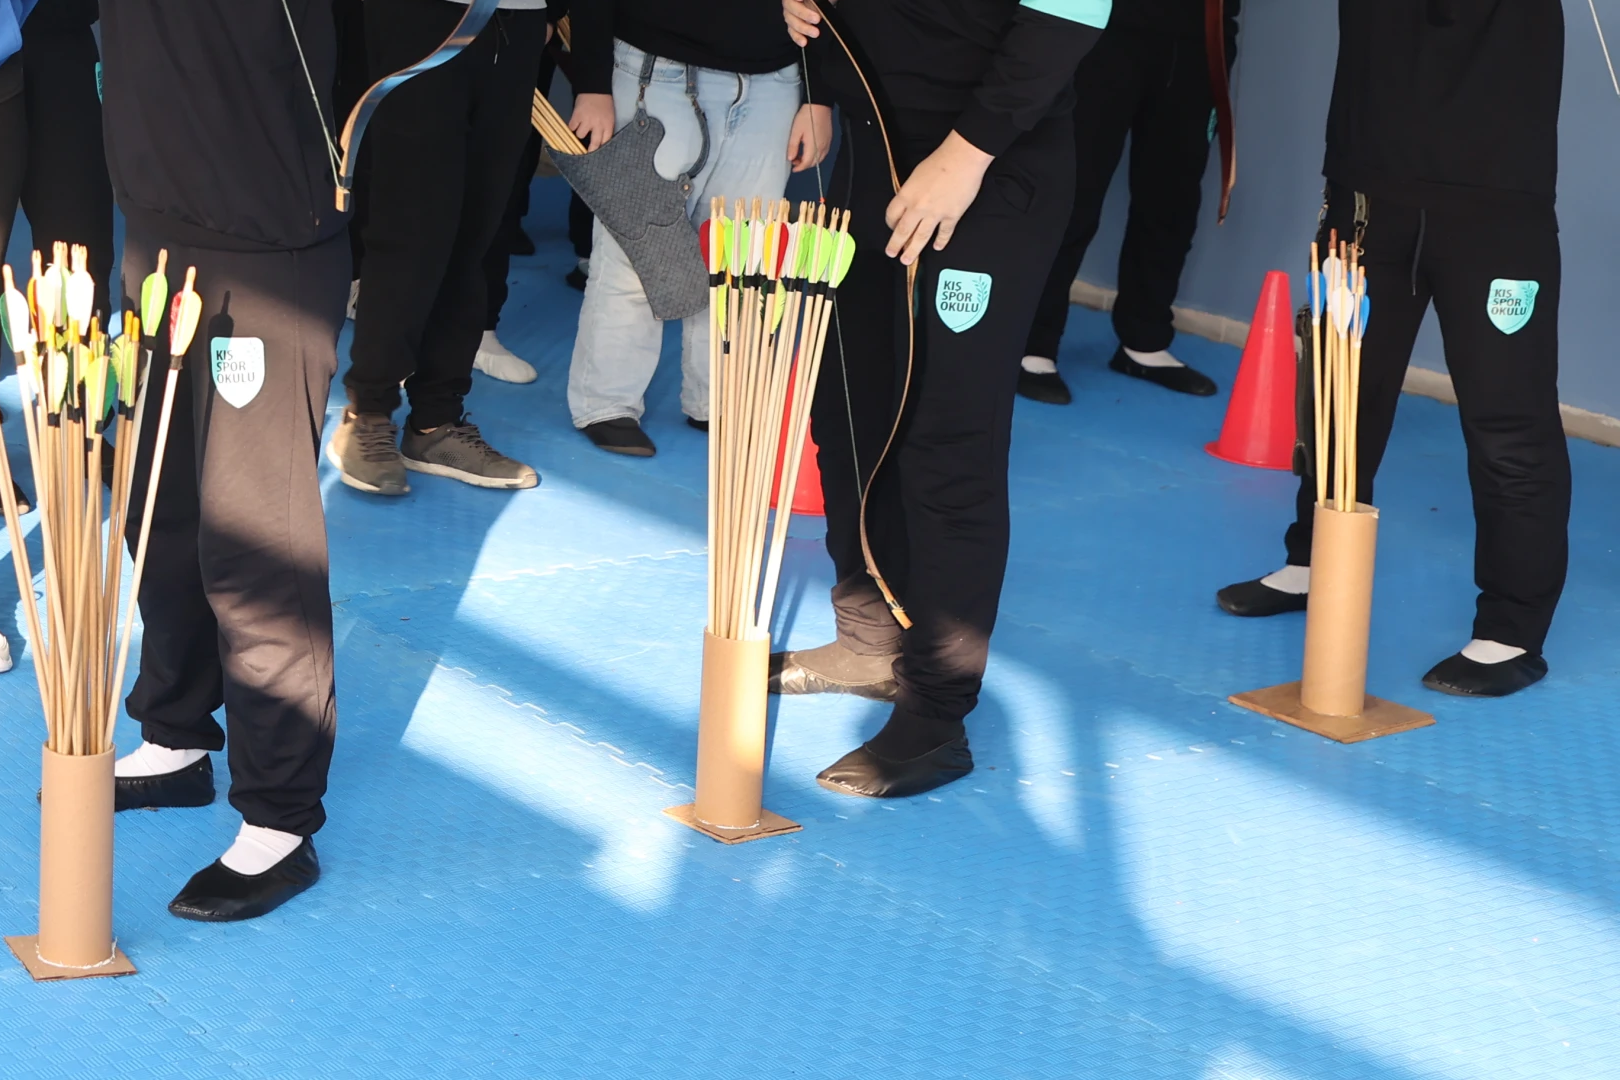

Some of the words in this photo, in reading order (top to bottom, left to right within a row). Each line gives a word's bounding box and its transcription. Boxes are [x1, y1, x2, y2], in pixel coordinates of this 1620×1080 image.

[942, 291, 972, 302] SPOR
[1492, 298, 1522, 306] SPOR
[940, 302, 980, 313] OKULU
[1490, 306, 1527, 316] OKULU
[216, 361, 246, 372] SPOR
[216, 372, 256, 384] OKULU
